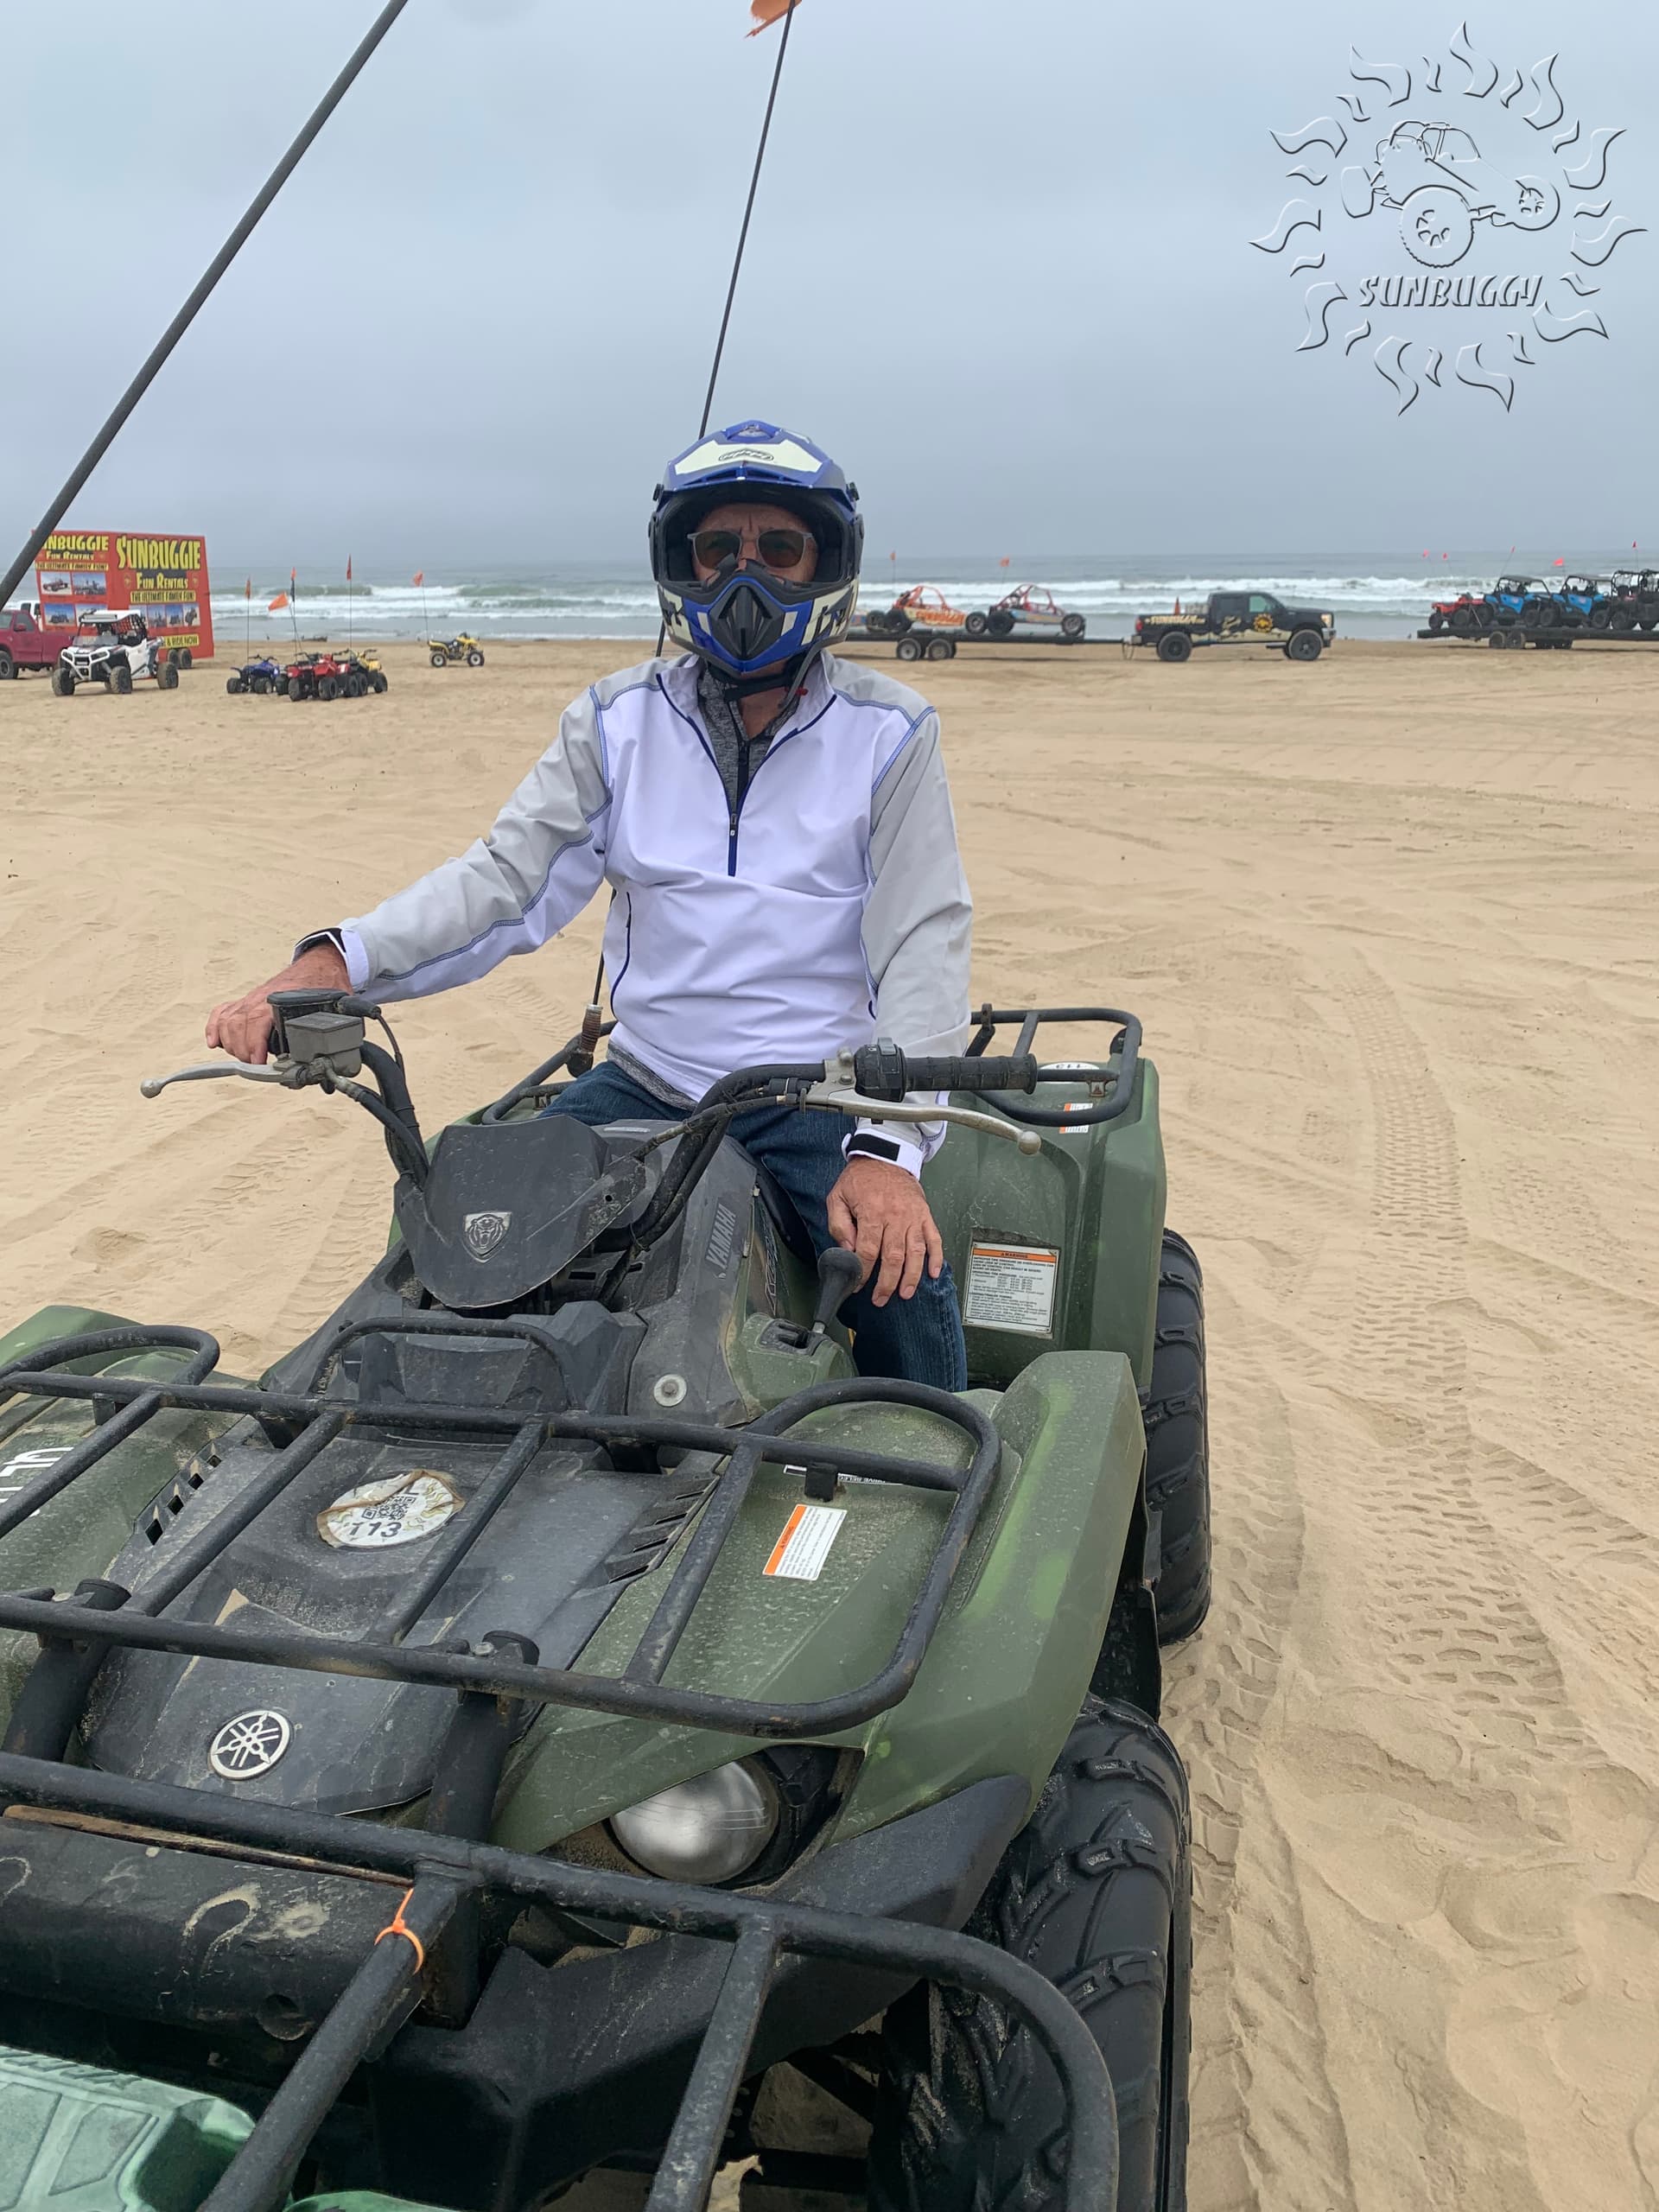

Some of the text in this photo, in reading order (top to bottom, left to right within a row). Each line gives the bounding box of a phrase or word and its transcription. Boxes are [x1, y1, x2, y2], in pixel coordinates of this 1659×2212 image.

[44, 535, 109, 550] NBUGGIE
[116, 535, 200, 569] SUNBUGGIE
[136, 572, 188, 589] FUN RENTALS
[705, 1202, 737, 1270] YAMAHA
